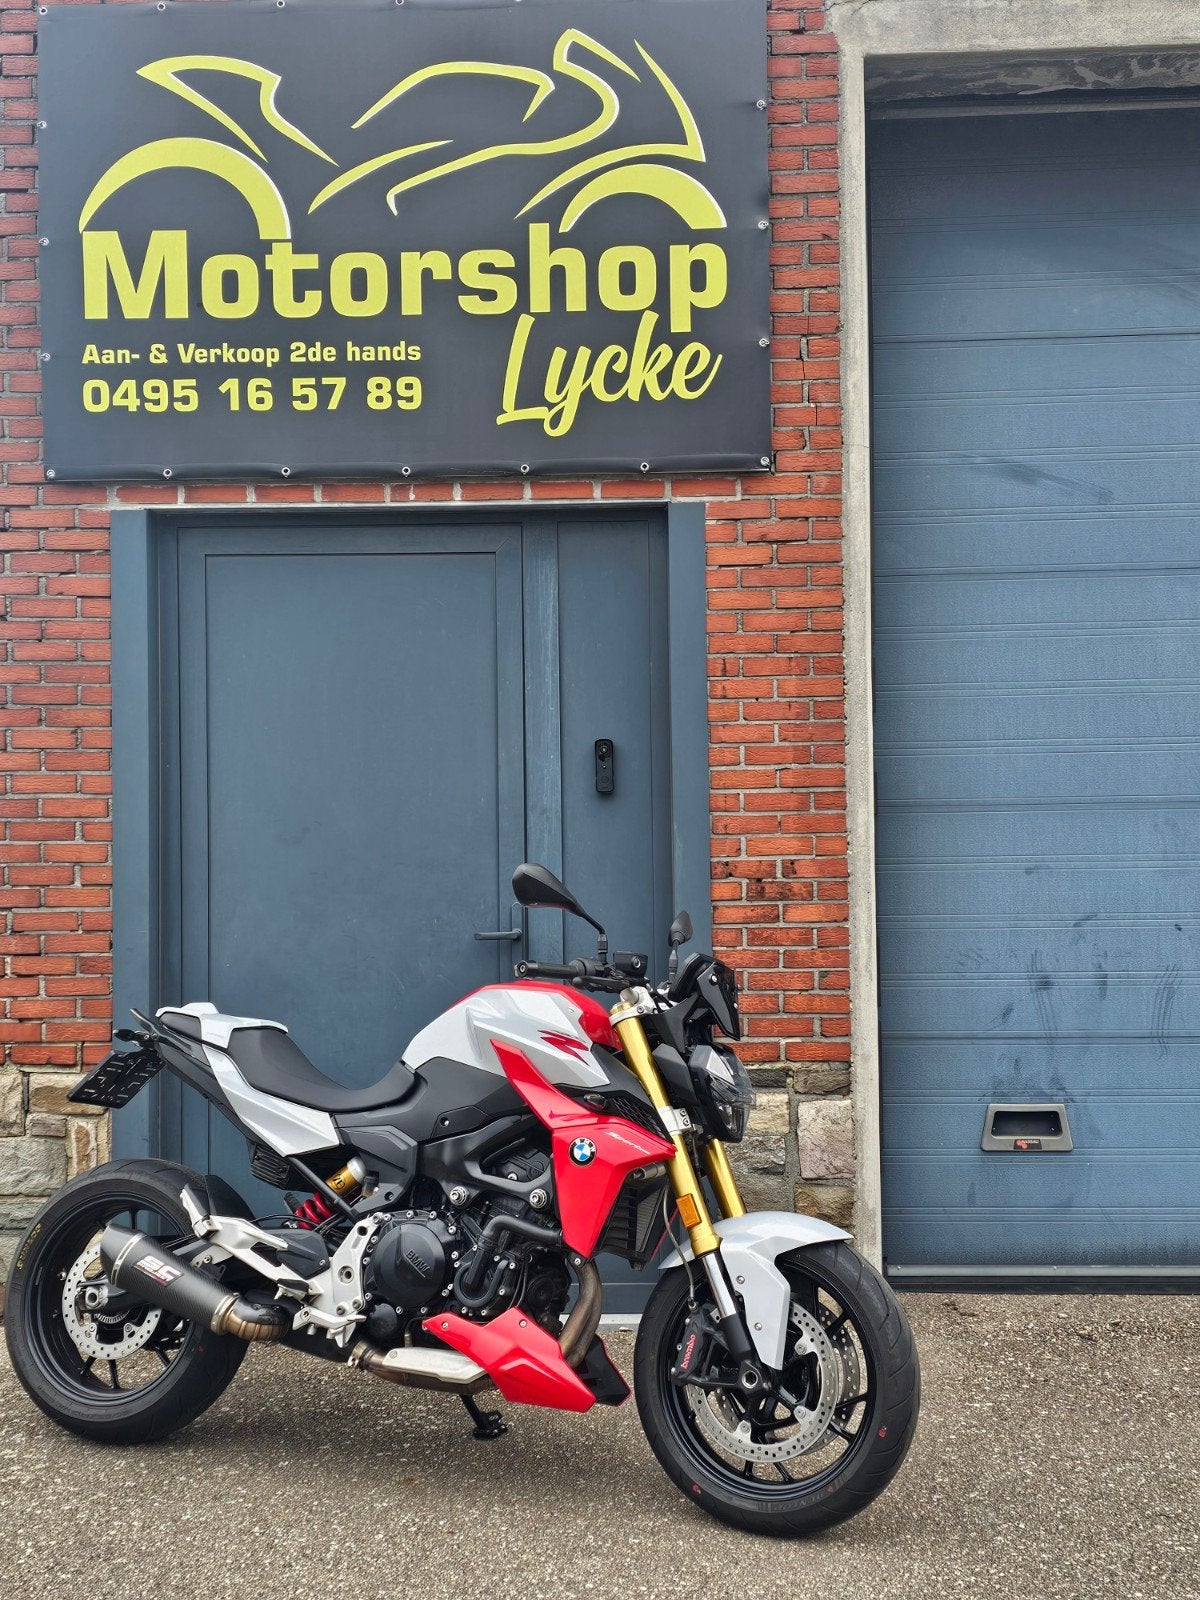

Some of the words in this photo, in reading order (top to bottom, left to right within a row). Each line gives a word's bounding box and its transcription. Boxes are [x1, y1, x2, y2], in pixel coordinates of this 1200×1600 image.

[81, 223, 728, 332] Motorshop
[82, 343, 140, 364] Aan-
[149, 344, 168, 363] &
[178, 343, 280, 365] Verkoop
[289, 342, 335, 363] 2de
[346, 342, 422, 362] hands
[496, 310, 723, 437] Lycke
[82, 378, 199, 413] 0495
[219, 377, 274, 412] 16
[291, 377, 347, 411] 57
[366, 375, 423, 411] 89
[405, 1248, 431, 1272] BMW
[680, 1334, 697, 1370] brembo
